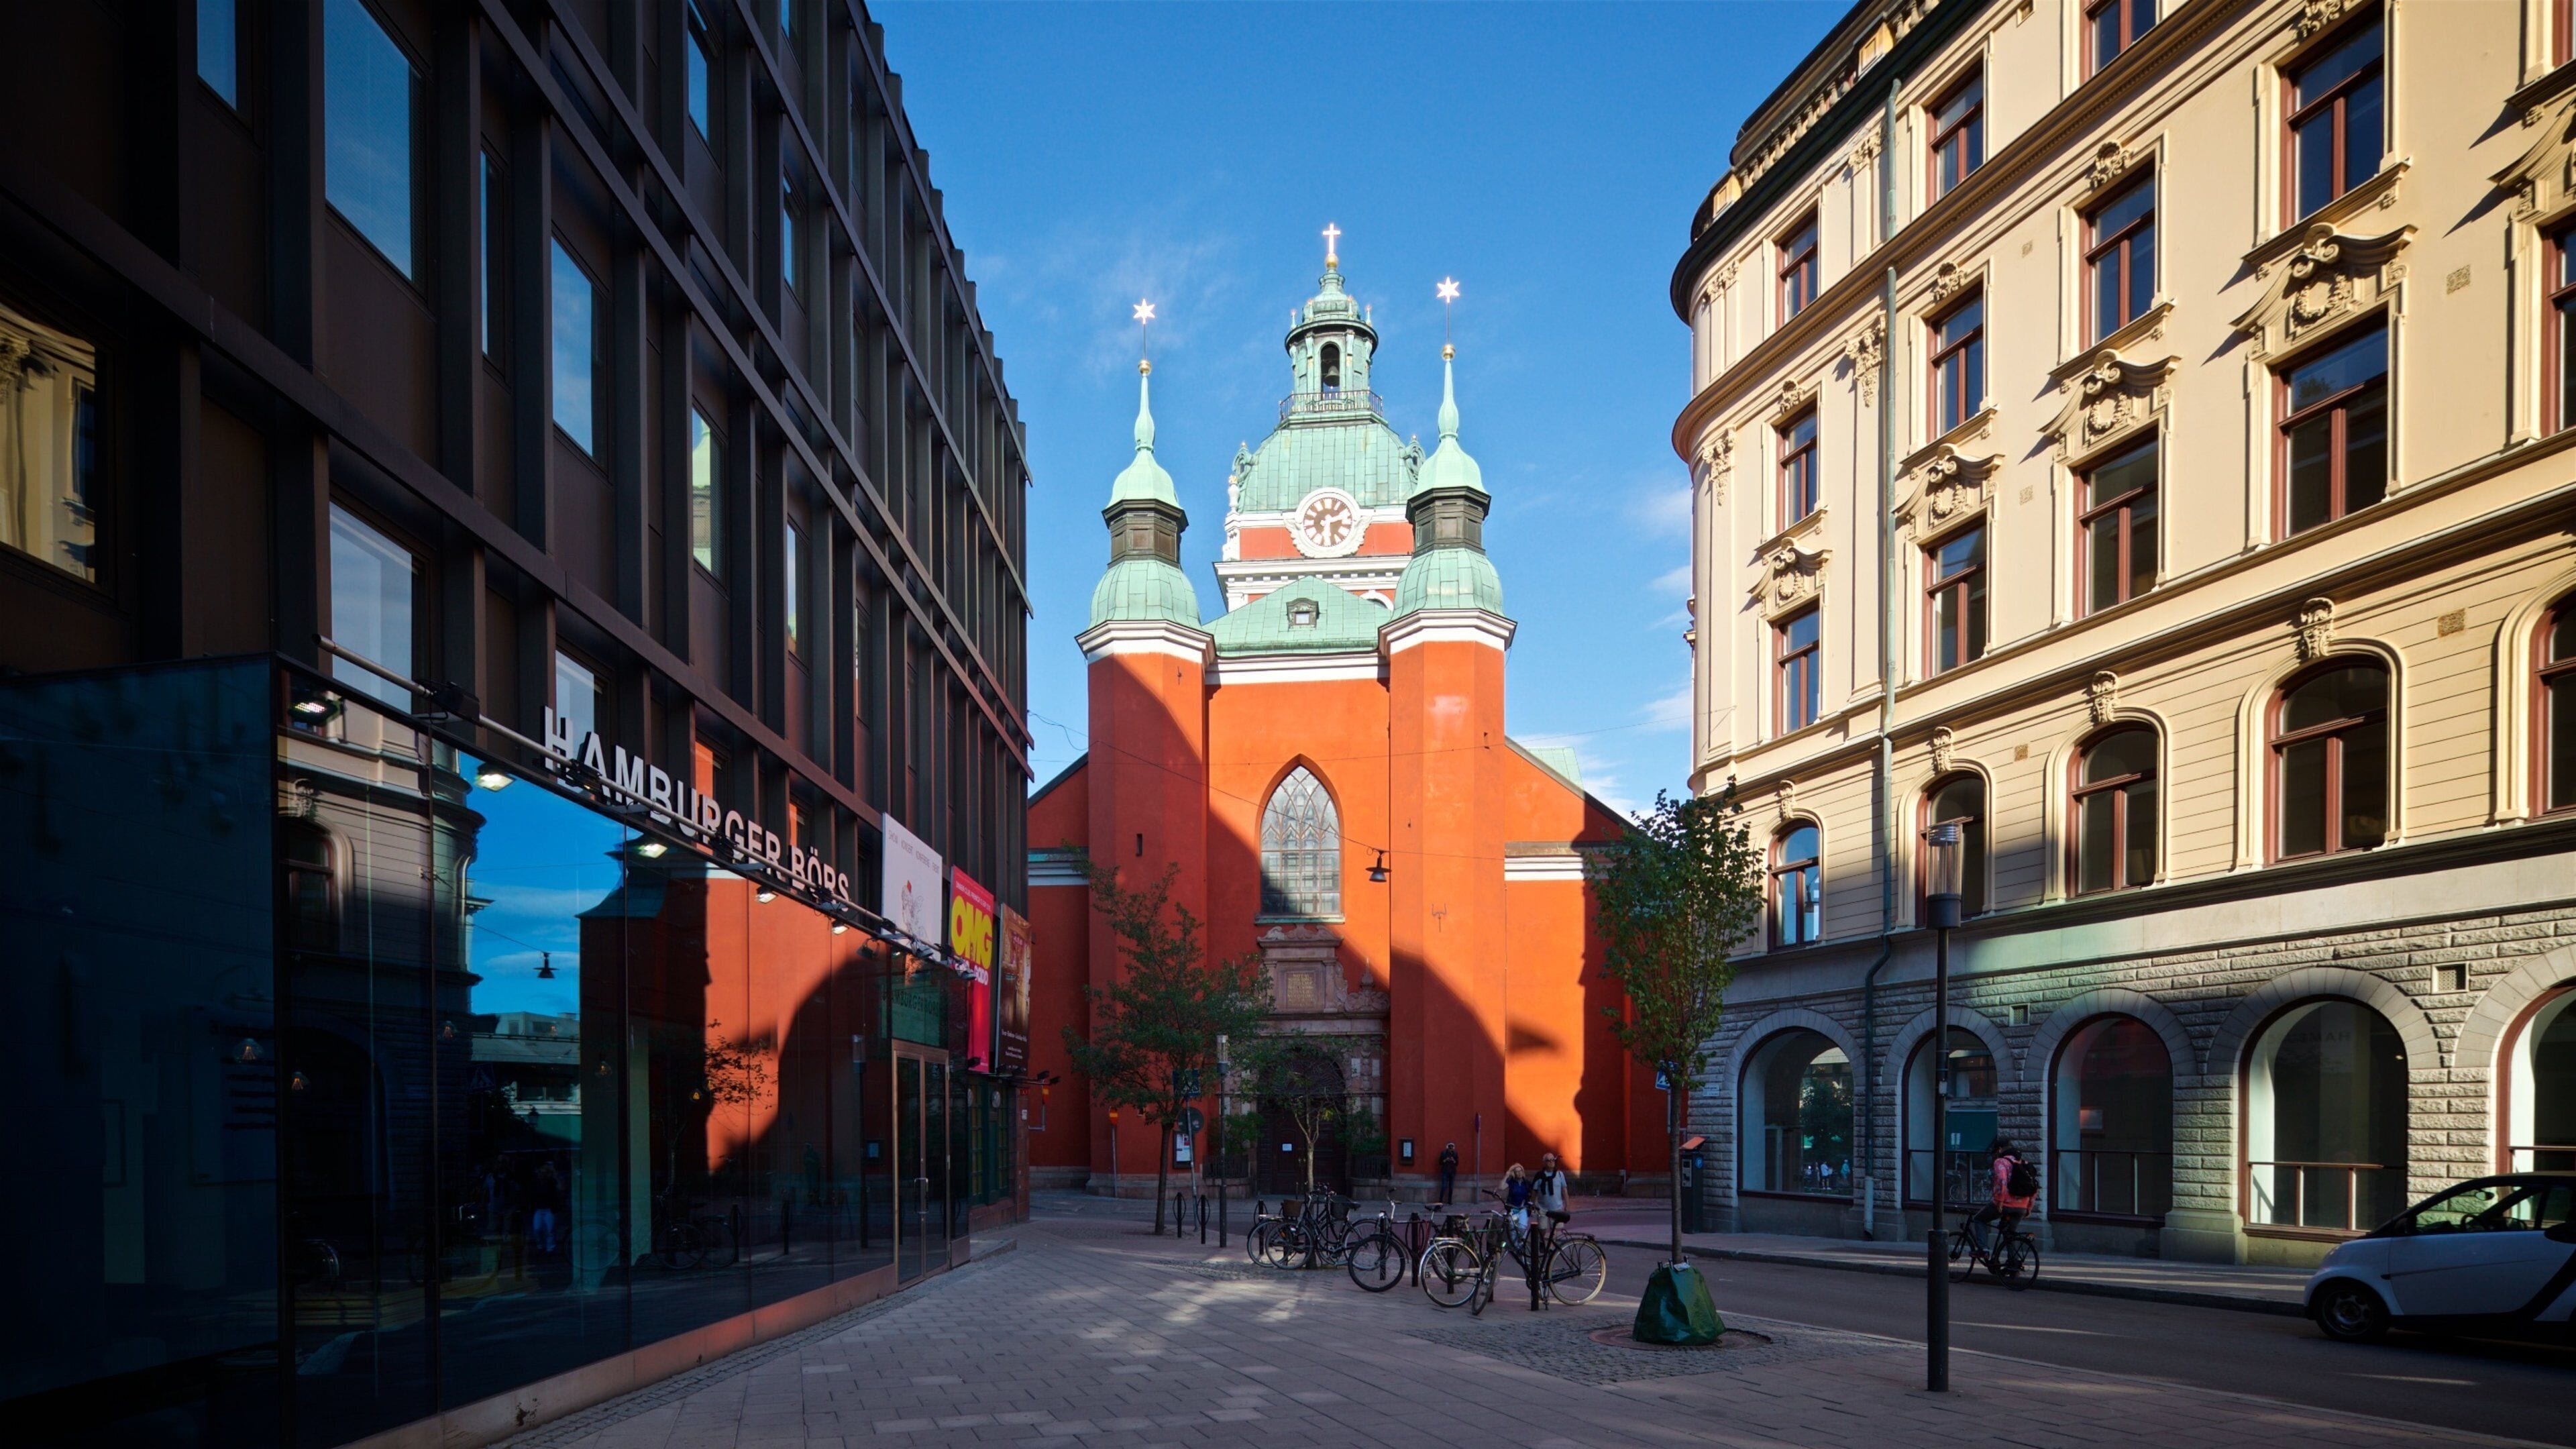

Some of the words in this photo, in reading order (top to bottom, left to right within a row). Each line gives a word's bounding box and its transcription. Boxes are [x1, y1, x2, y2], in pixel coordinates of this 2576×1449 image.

[544, 706, 786, 881] HAMBURGER
[789, 845, 850, 912] BÖRS
[951, 896, 993, 969] OMG
